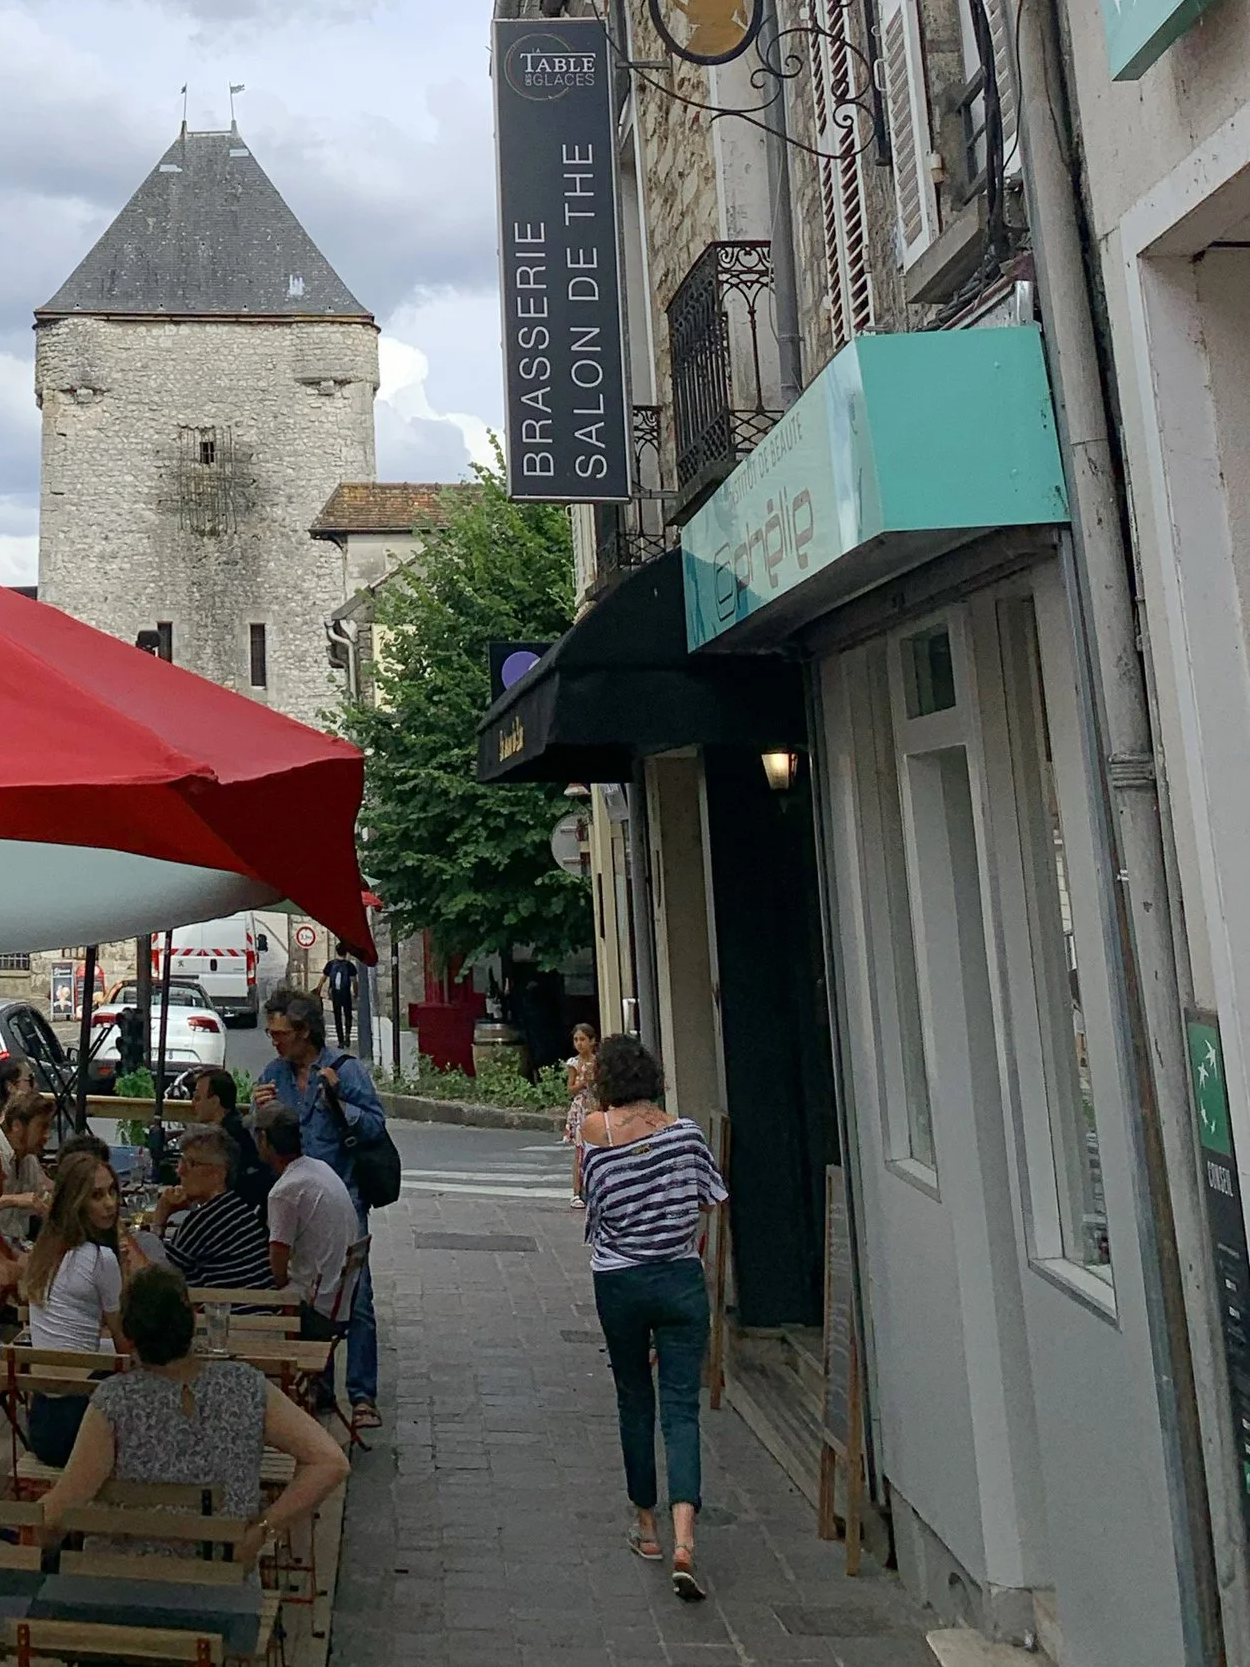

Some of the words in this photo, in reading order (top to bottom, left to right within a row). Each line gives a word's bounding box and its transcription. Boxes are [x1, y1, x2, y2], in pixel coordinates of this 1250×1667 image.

[533, 73, 595, 86] GLACES
[562, 143, 596, 226] THE
[566, 247, 599, 302] DE
[514, 221, 555, 477] BRASSERIE
[570, 327, 608, 479] SALON
